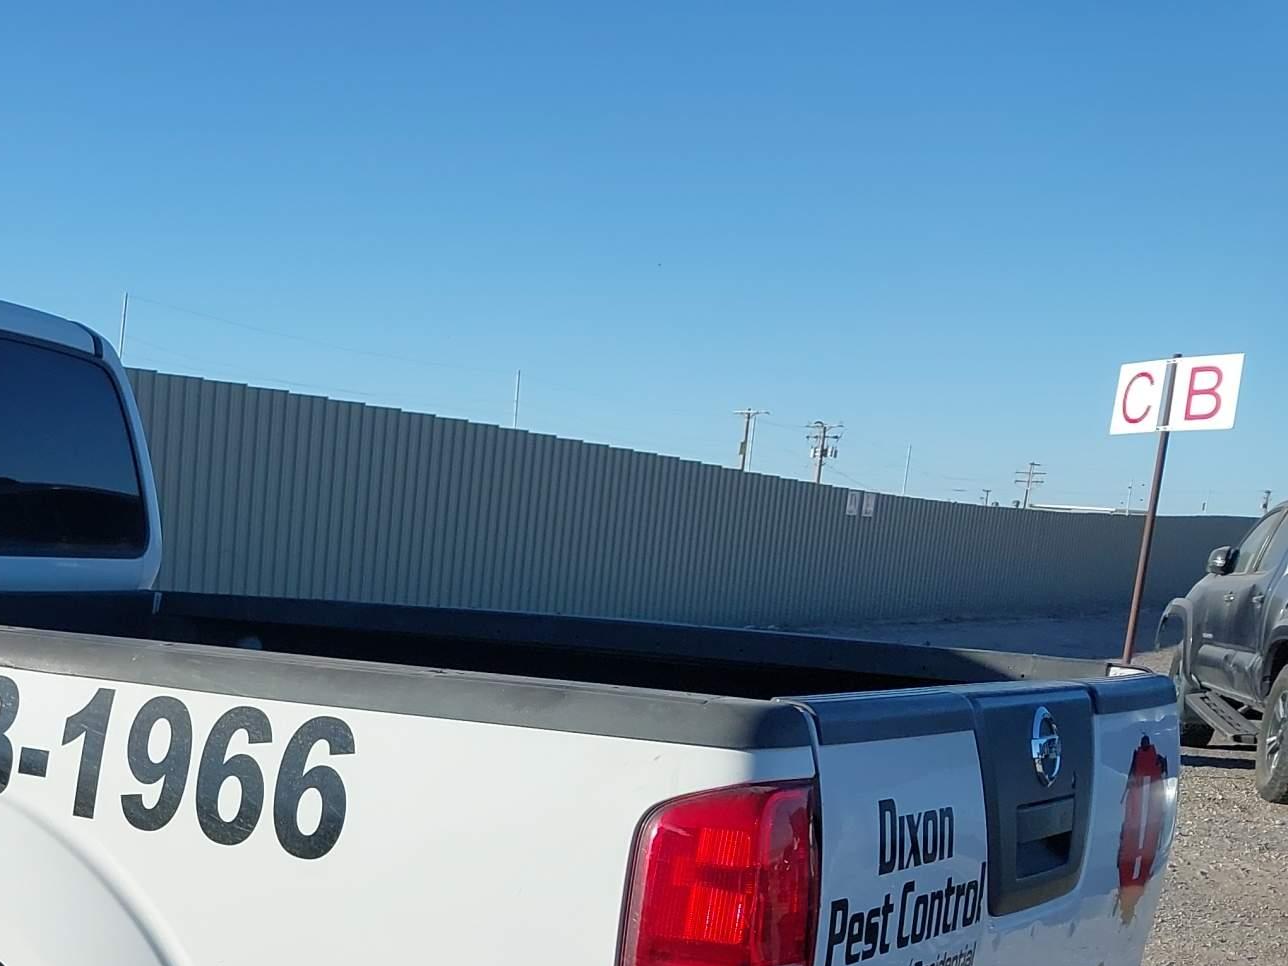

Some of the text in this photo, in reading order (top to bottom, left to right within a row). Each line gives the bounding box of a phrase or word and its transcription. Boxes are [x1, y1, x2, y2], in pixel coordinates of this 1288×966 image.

[1122, 366, 1224, 424] C B
[878, 798, 955, 876] Dixon
[896, 862, 987, 947] Control
